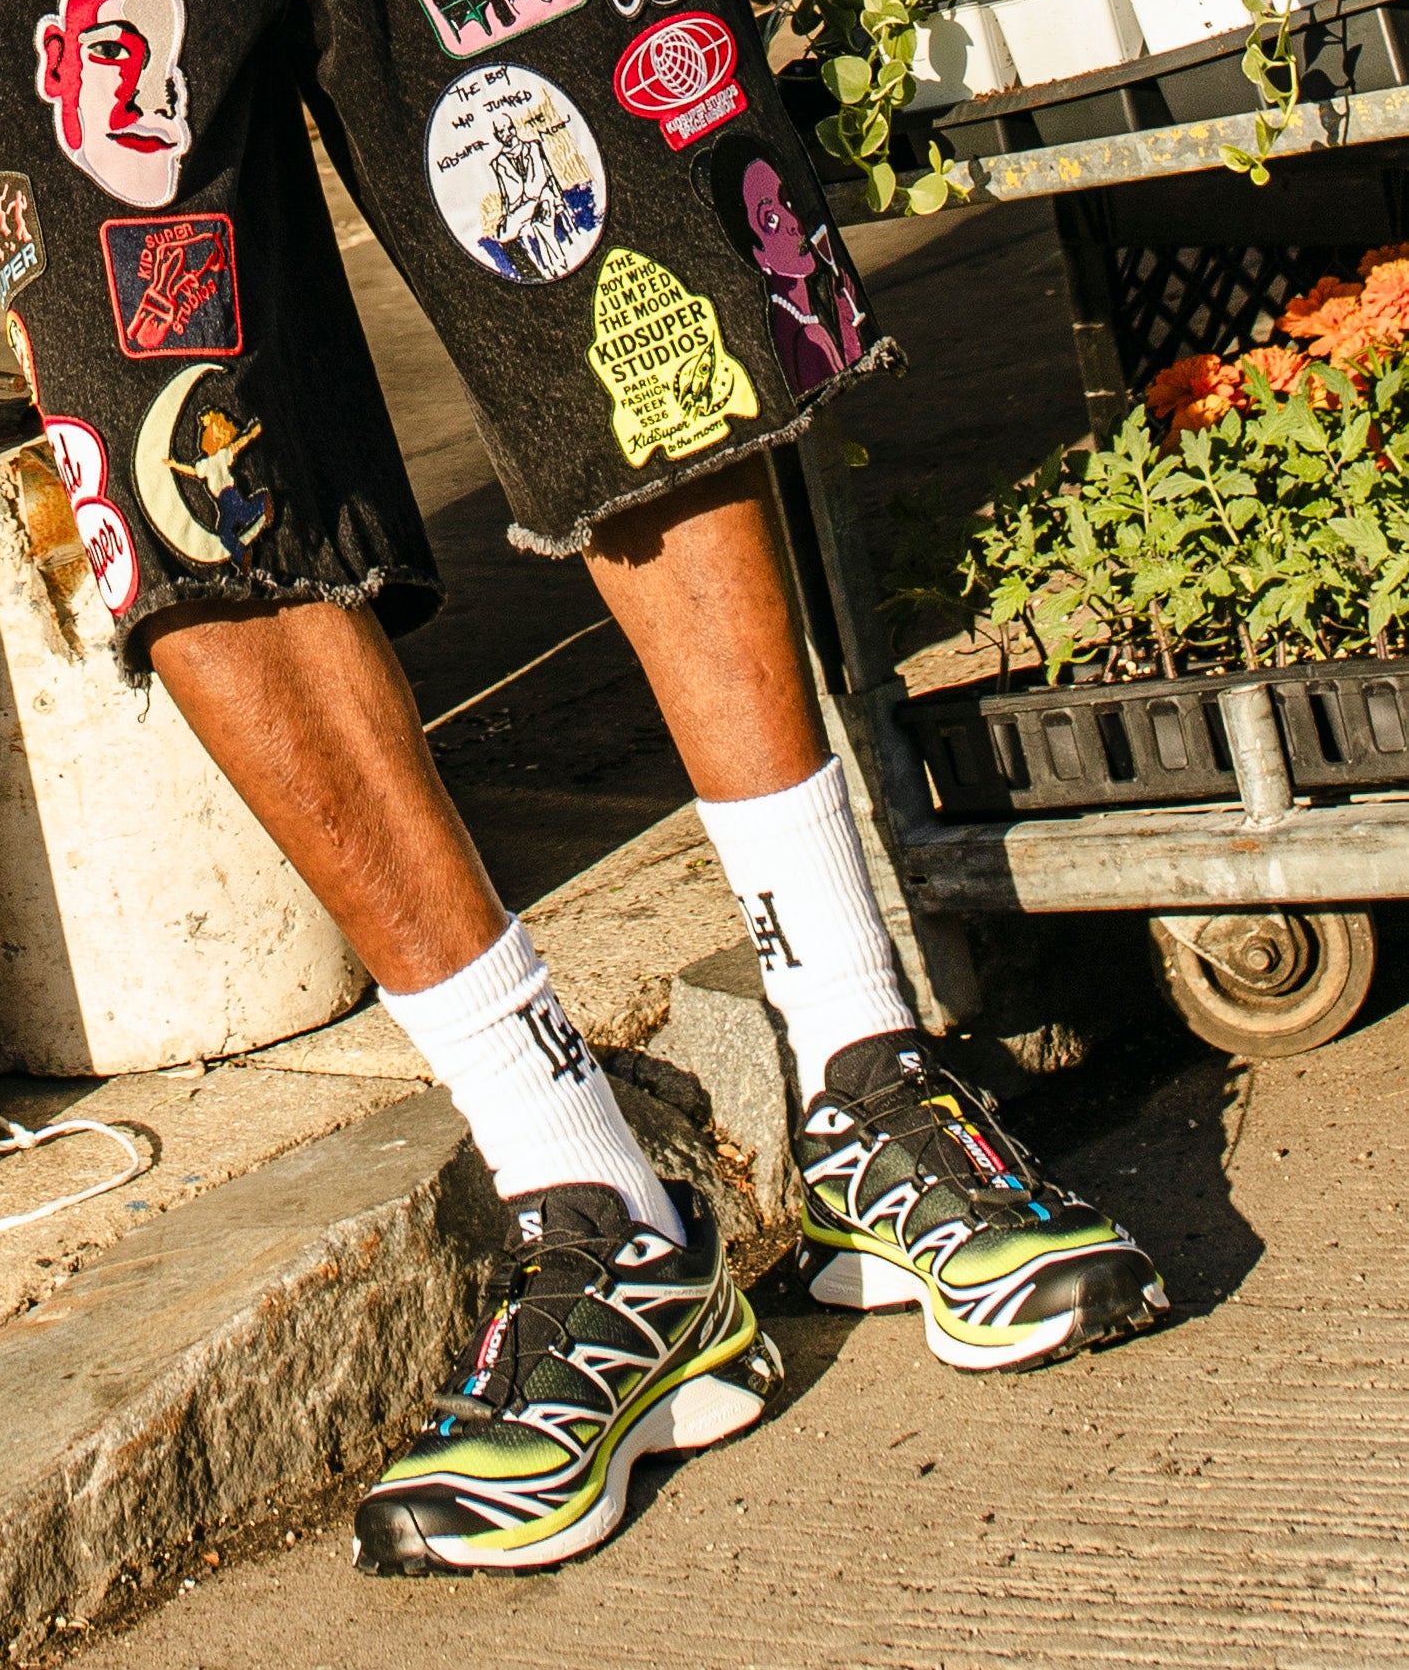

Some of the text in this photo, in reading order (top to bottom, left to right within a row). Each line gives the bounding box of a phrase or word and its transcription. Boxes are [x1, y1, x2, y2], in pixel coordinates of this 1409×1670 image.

[484, 64, 510, 85] BOY
[137, 222, 194, 280] KID SUPER
[606, 252, 636, 274] THE
[598, 273, 672, 317] JUMPED
[599, 262, 657, 296] BOY WHO
[172, 278, 217, 336] STUDIOS
[599, 286, 683, 334] THE MOON
[594, 299, 708, 365] KIDSUPER
[611, 326, 709, 383] STUDIOS
[620, 382, 671, 409] FASHION
[623, 374, 660, 396] PARIS
[632, 396, 667, 417] WEEK
[639, 410, 669, 429] SS26
[677, 433, 692, 449] the
[693, 418, 724, 442] moon
